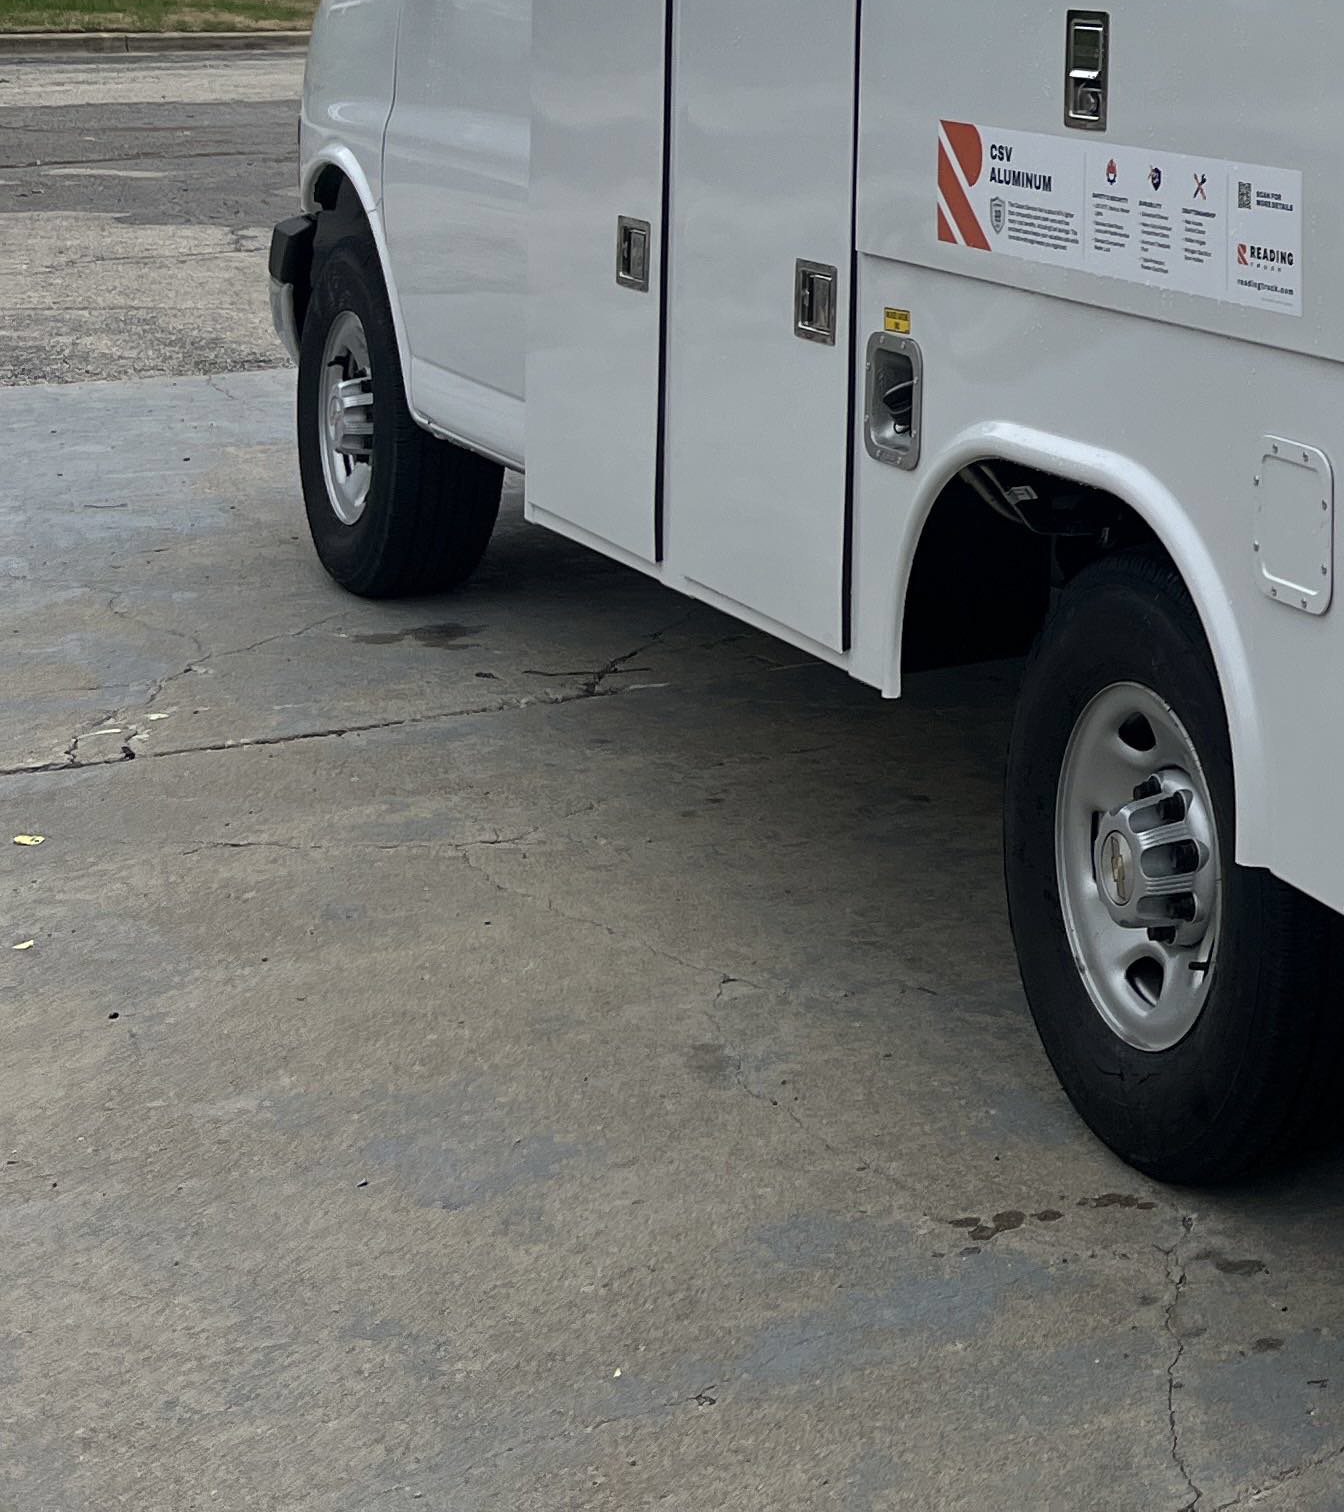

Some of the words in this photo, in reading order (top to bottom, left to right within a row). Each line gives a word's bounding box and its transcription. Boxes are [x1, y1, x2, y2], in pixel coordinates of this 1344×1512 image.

[990, 144, 1013, 163] CSV
[989, 166, 1053, 192] ALUMINUM
[1271, 192, 1282, 201] FOR
[1271, 201, 1294, 212] DETAILS
[1249, 245, 1294, 266] READING
